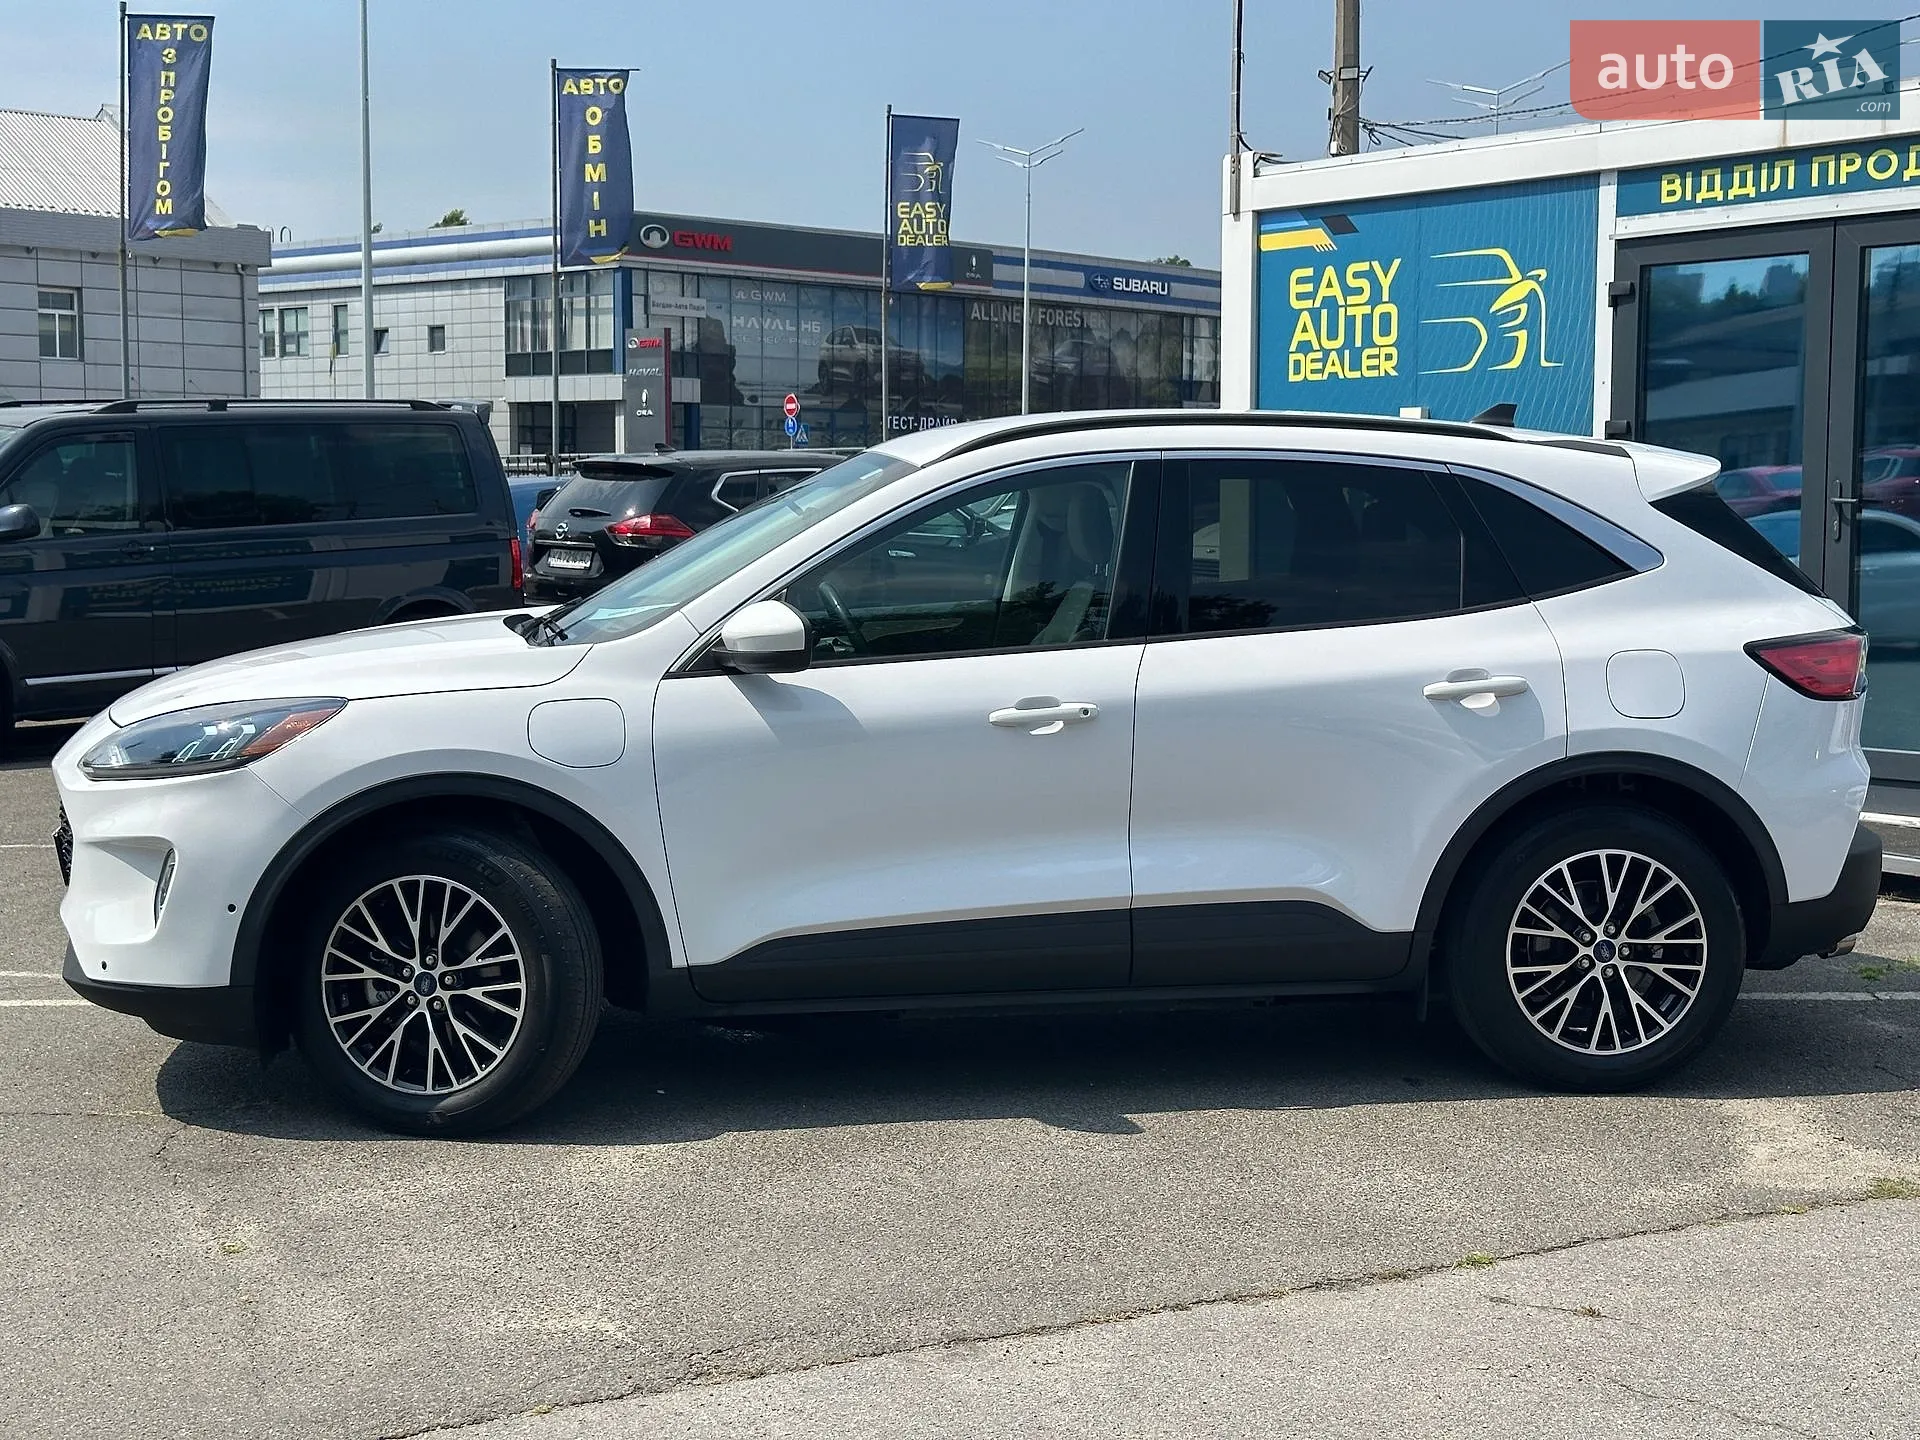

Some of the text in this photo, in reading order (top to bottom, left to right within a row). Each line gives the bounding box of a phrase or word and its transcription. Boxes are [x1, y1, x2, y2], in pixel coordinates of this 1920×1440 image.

[136, 23, 208, 41] АВТО
[562, 78, 625, 95] АВТО
[155, 47, 177, 215] З ПРОБІГОМ
[584, 106, 607, 238] ОБМІН
[1660, 158, 1796, 203] ВІДДІЛ
[897, 201, 947, 219] EASY
[898, 218, 947, 235] AUTO
[673, 231, 733, 251] GWM
[897, 234, 949, 246] DEALER
[1112, 277, 1168, 295] SUBARU
[1289, 258, 1402, 310] EASY
[751, 290, 786, 302] GWM
[971, 302, 999, 321] ALL
[732, 316, 821, 333] HAVAL H6
[1289, 303, 1398, 352] AUTO
[1288, 346, 1399, 382] DEALER
